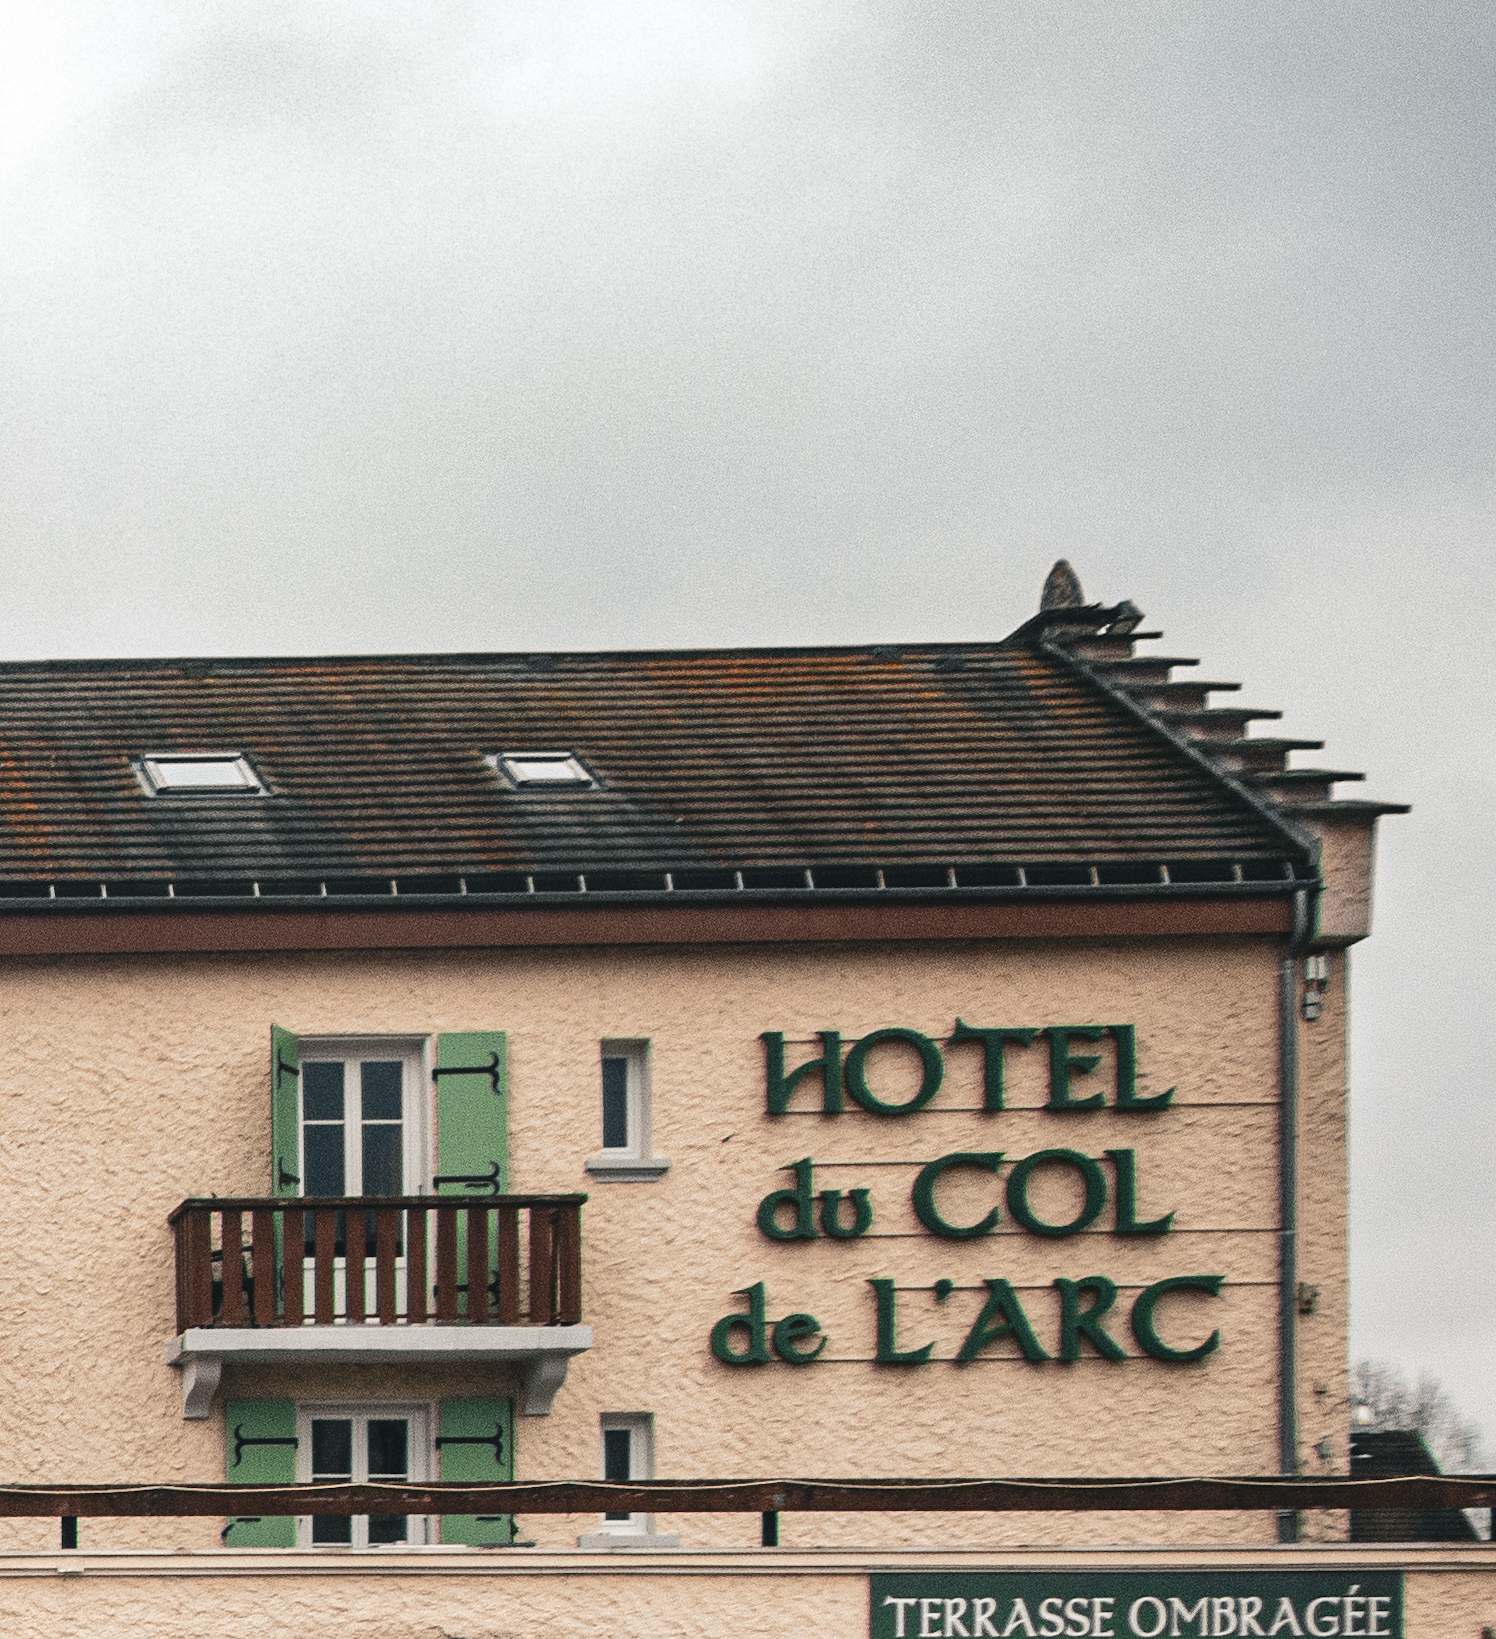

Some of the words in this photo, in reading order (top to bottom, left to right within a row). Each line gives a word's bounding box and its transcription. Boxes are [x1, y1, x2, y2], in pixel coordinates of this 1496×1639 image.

[758, 1017, 1177, 1117] HOTEL
[756, 1156, 875, 1242] du
[911, 1147, 1177, 1240] COL
[710, 1280, 828, 1366] de
[866, 1275, 1226, 1366] L'ARC
[883, 1594, 1116, 1638] TERRASSE
[1127, 1583, 1392, 1638] OMBRAGÉE
